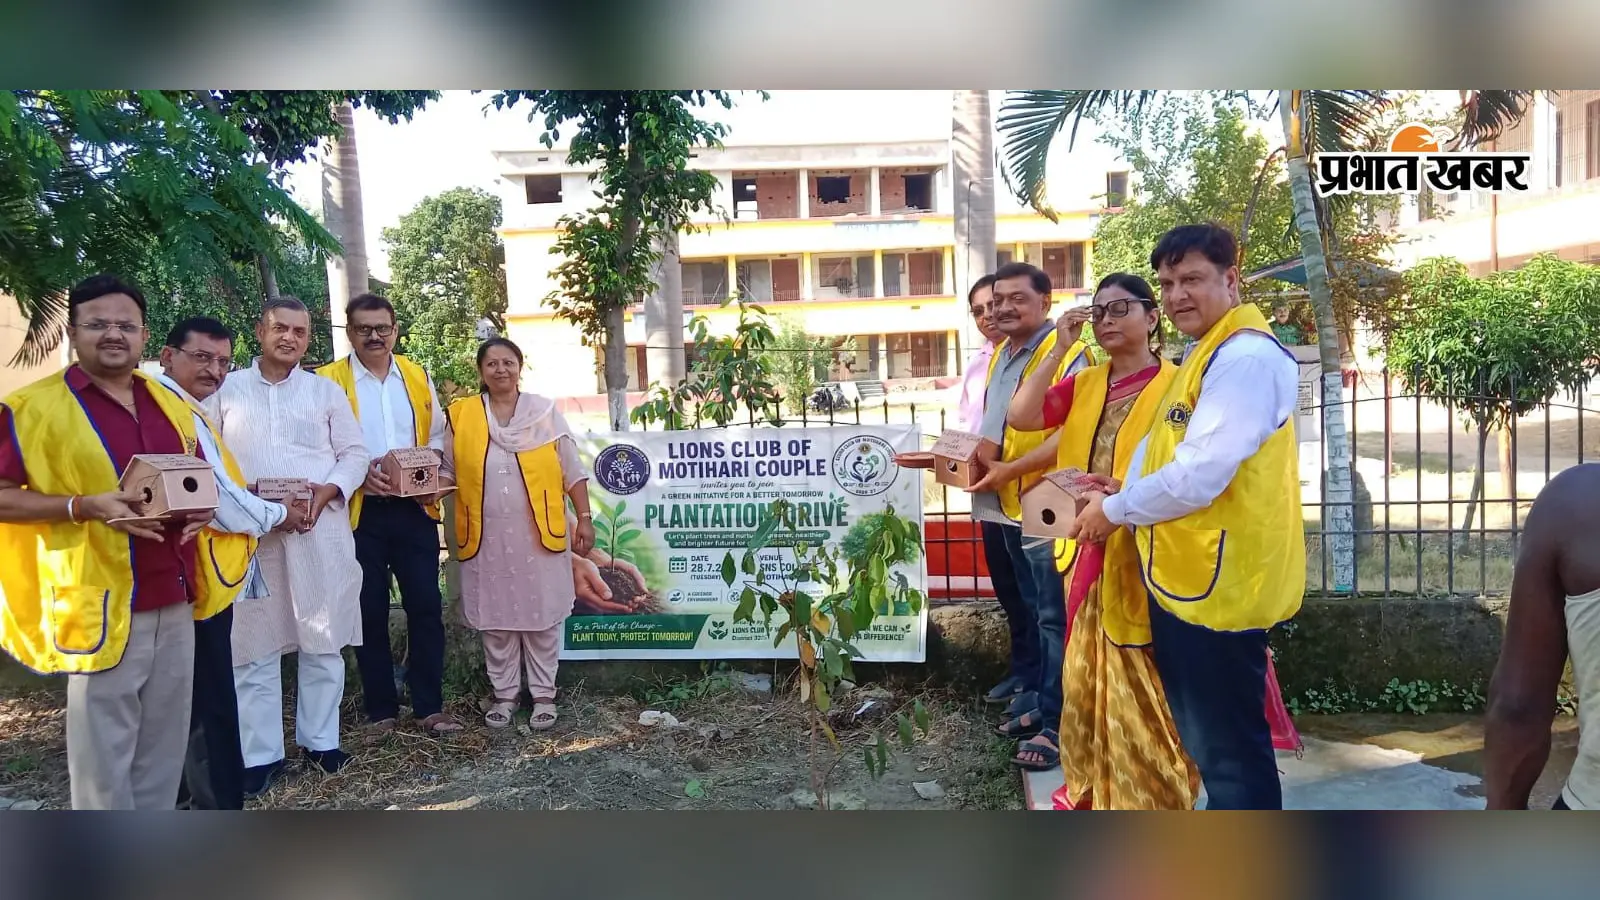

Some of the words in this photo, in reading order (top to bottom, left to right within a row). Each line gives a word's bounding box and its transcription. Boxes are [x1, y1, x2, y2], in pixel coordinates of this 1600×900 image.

[668, 442, 725, 459] LIONS
[731, 440, 781, 458] CLUB
[788, 439, 812, 457] OF
[659, 460, 749, 479] MOTIHARI
[755, 459, 827, 477] COUPLE
[700, 481, 727, 489] invites
[729, 482, 745, 491] you
[747, 480, 756, 488] to
[755, 480, 775, 490] join
[752, 491, 780, 499] BETTER
[782, 490, 824, 498] TOMORROW
[645, 502, 773, 529] PLANTATION
[691, 563, 722, 573] 28.7.2
[760, 562, 777, 572] SNS
[573, 623, 583, 631] Be
[591, 622, 608, 630] Part
[608, 622, 616, 631] of
[617, 622, 628, 630] the
[750, 626, 765, 634] CLUB
[873, 624, 883, 632] WE
[884, 624, 898, 632] CAN
[572, 632, 594, 642] PLANT
[596, 632, 619, 643] TODAY,
[620, 632, 650, 641] PROTECT
[652, 631, 694, 641] TOMORROW!
[863, 633, 905, 641] DIFFERENCE!
